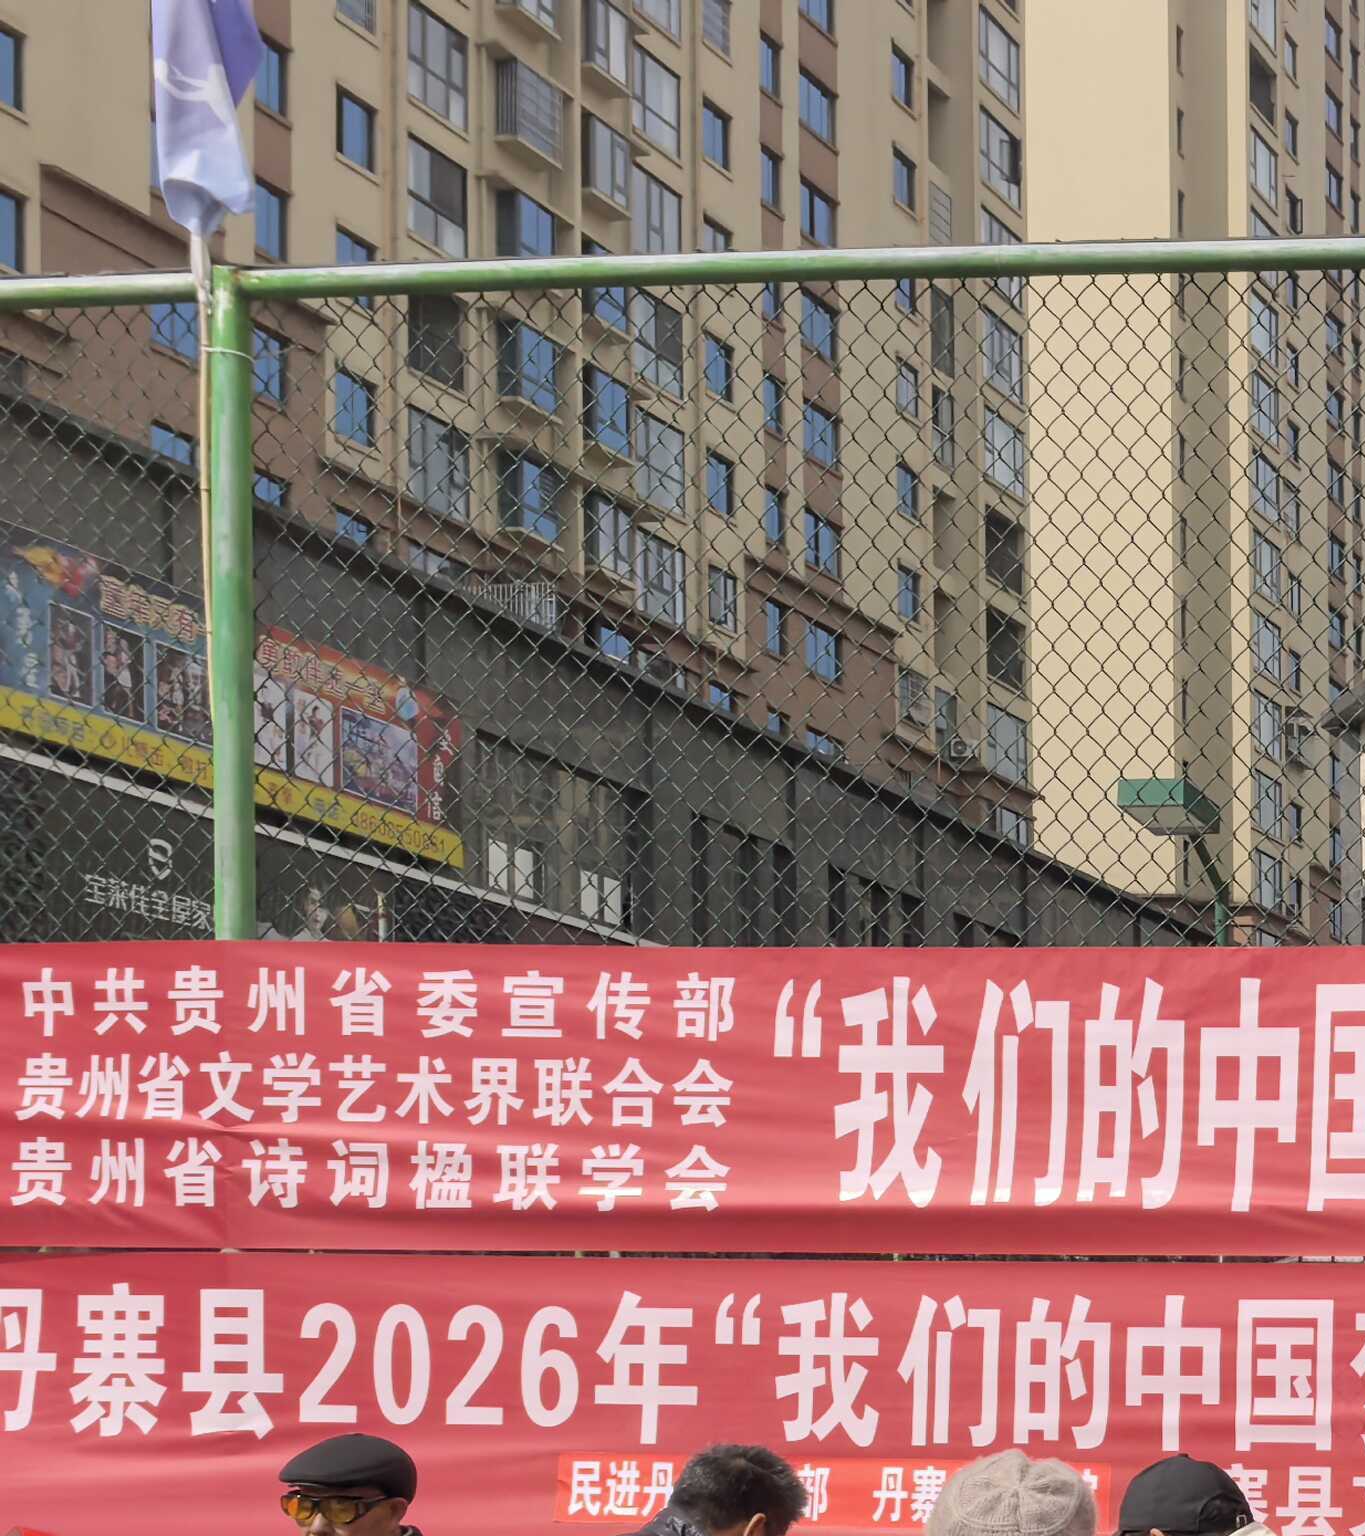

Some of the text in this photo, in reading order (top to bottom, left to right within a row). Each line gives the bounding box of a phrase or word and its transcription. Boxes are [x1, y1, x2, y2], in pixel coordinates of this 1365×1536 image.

[22, 964, 736, 1043] 中共贵州省委宣传部
[15, 1050, 734, 1128] 贵州省文学艺术界联合会
[10, 1135, 732, 1213] 贵州省诗词楹联学会
